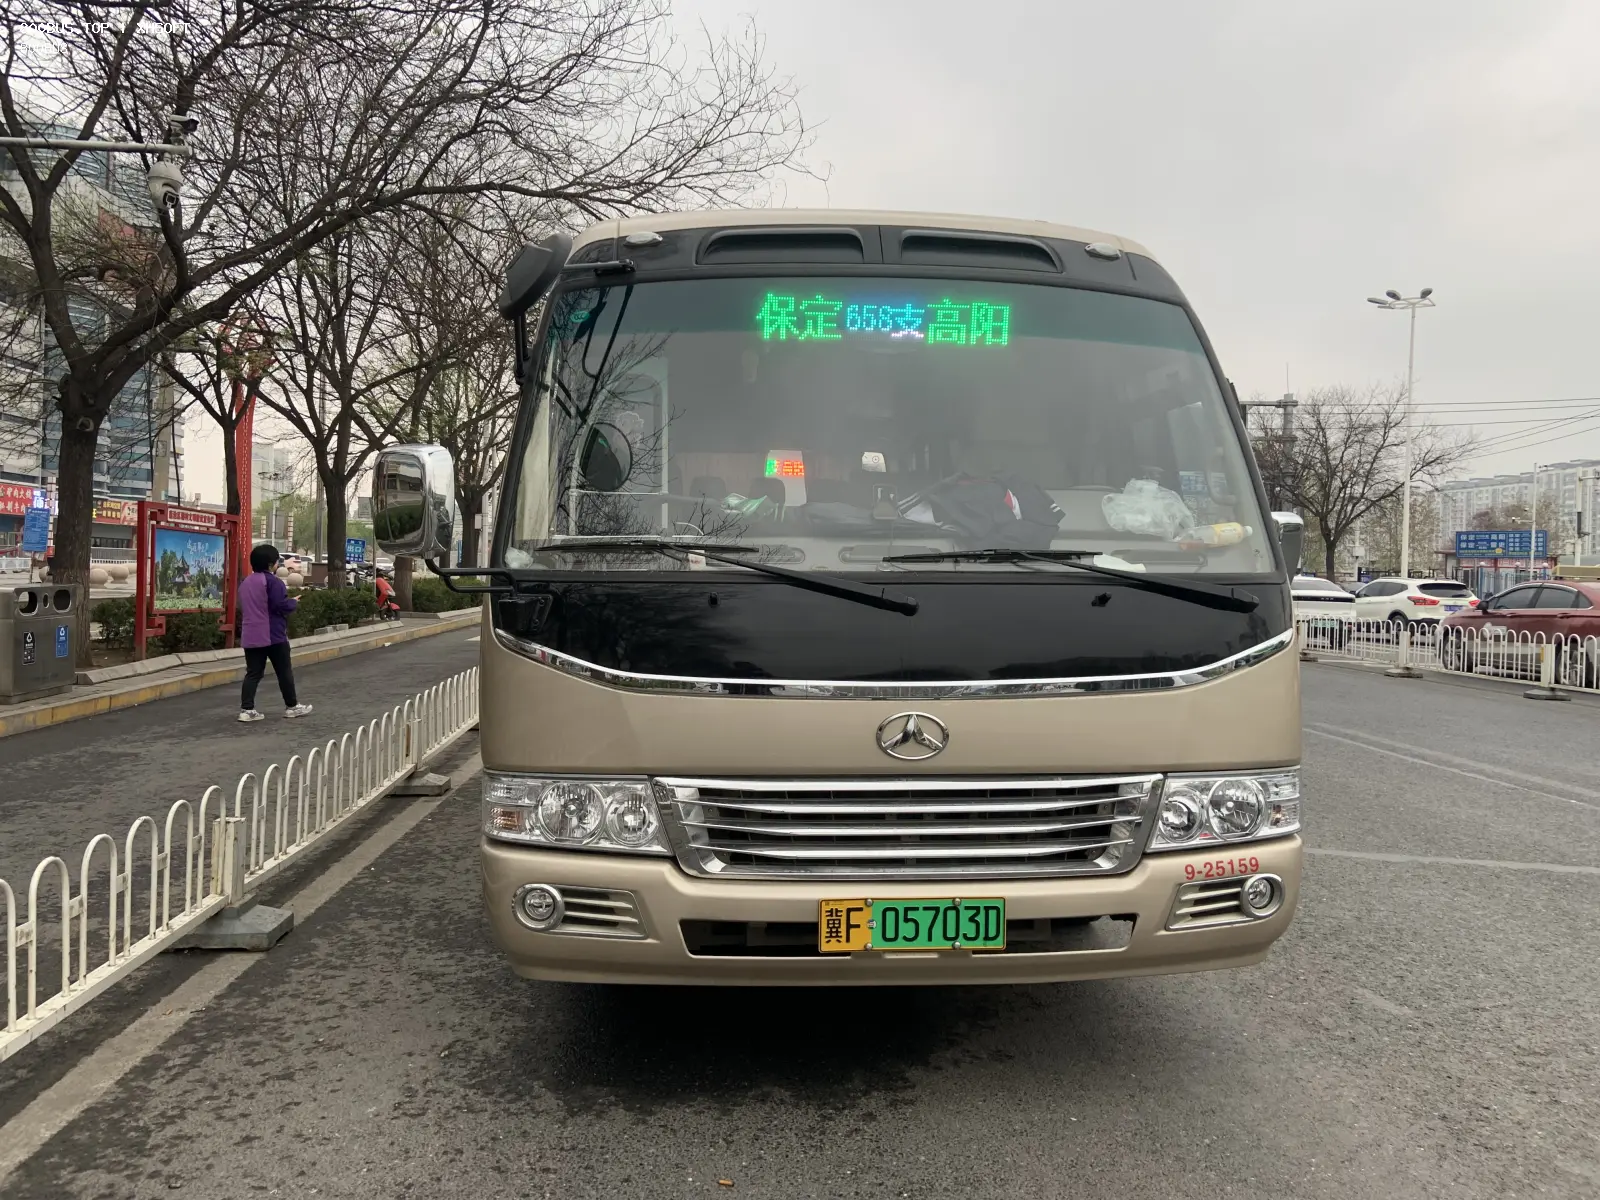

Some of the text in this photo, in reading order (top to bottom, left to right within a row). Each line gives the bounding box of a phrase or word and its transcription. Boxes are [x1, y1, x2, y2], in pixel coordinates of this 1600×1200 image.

[756, 293, 843, 340] 保定
[928, 298, 1011, 345] 高阳
[1184, 856, 1260, 880] 9-25159
[824, 904, 1001, 944] 冀F 05703D
